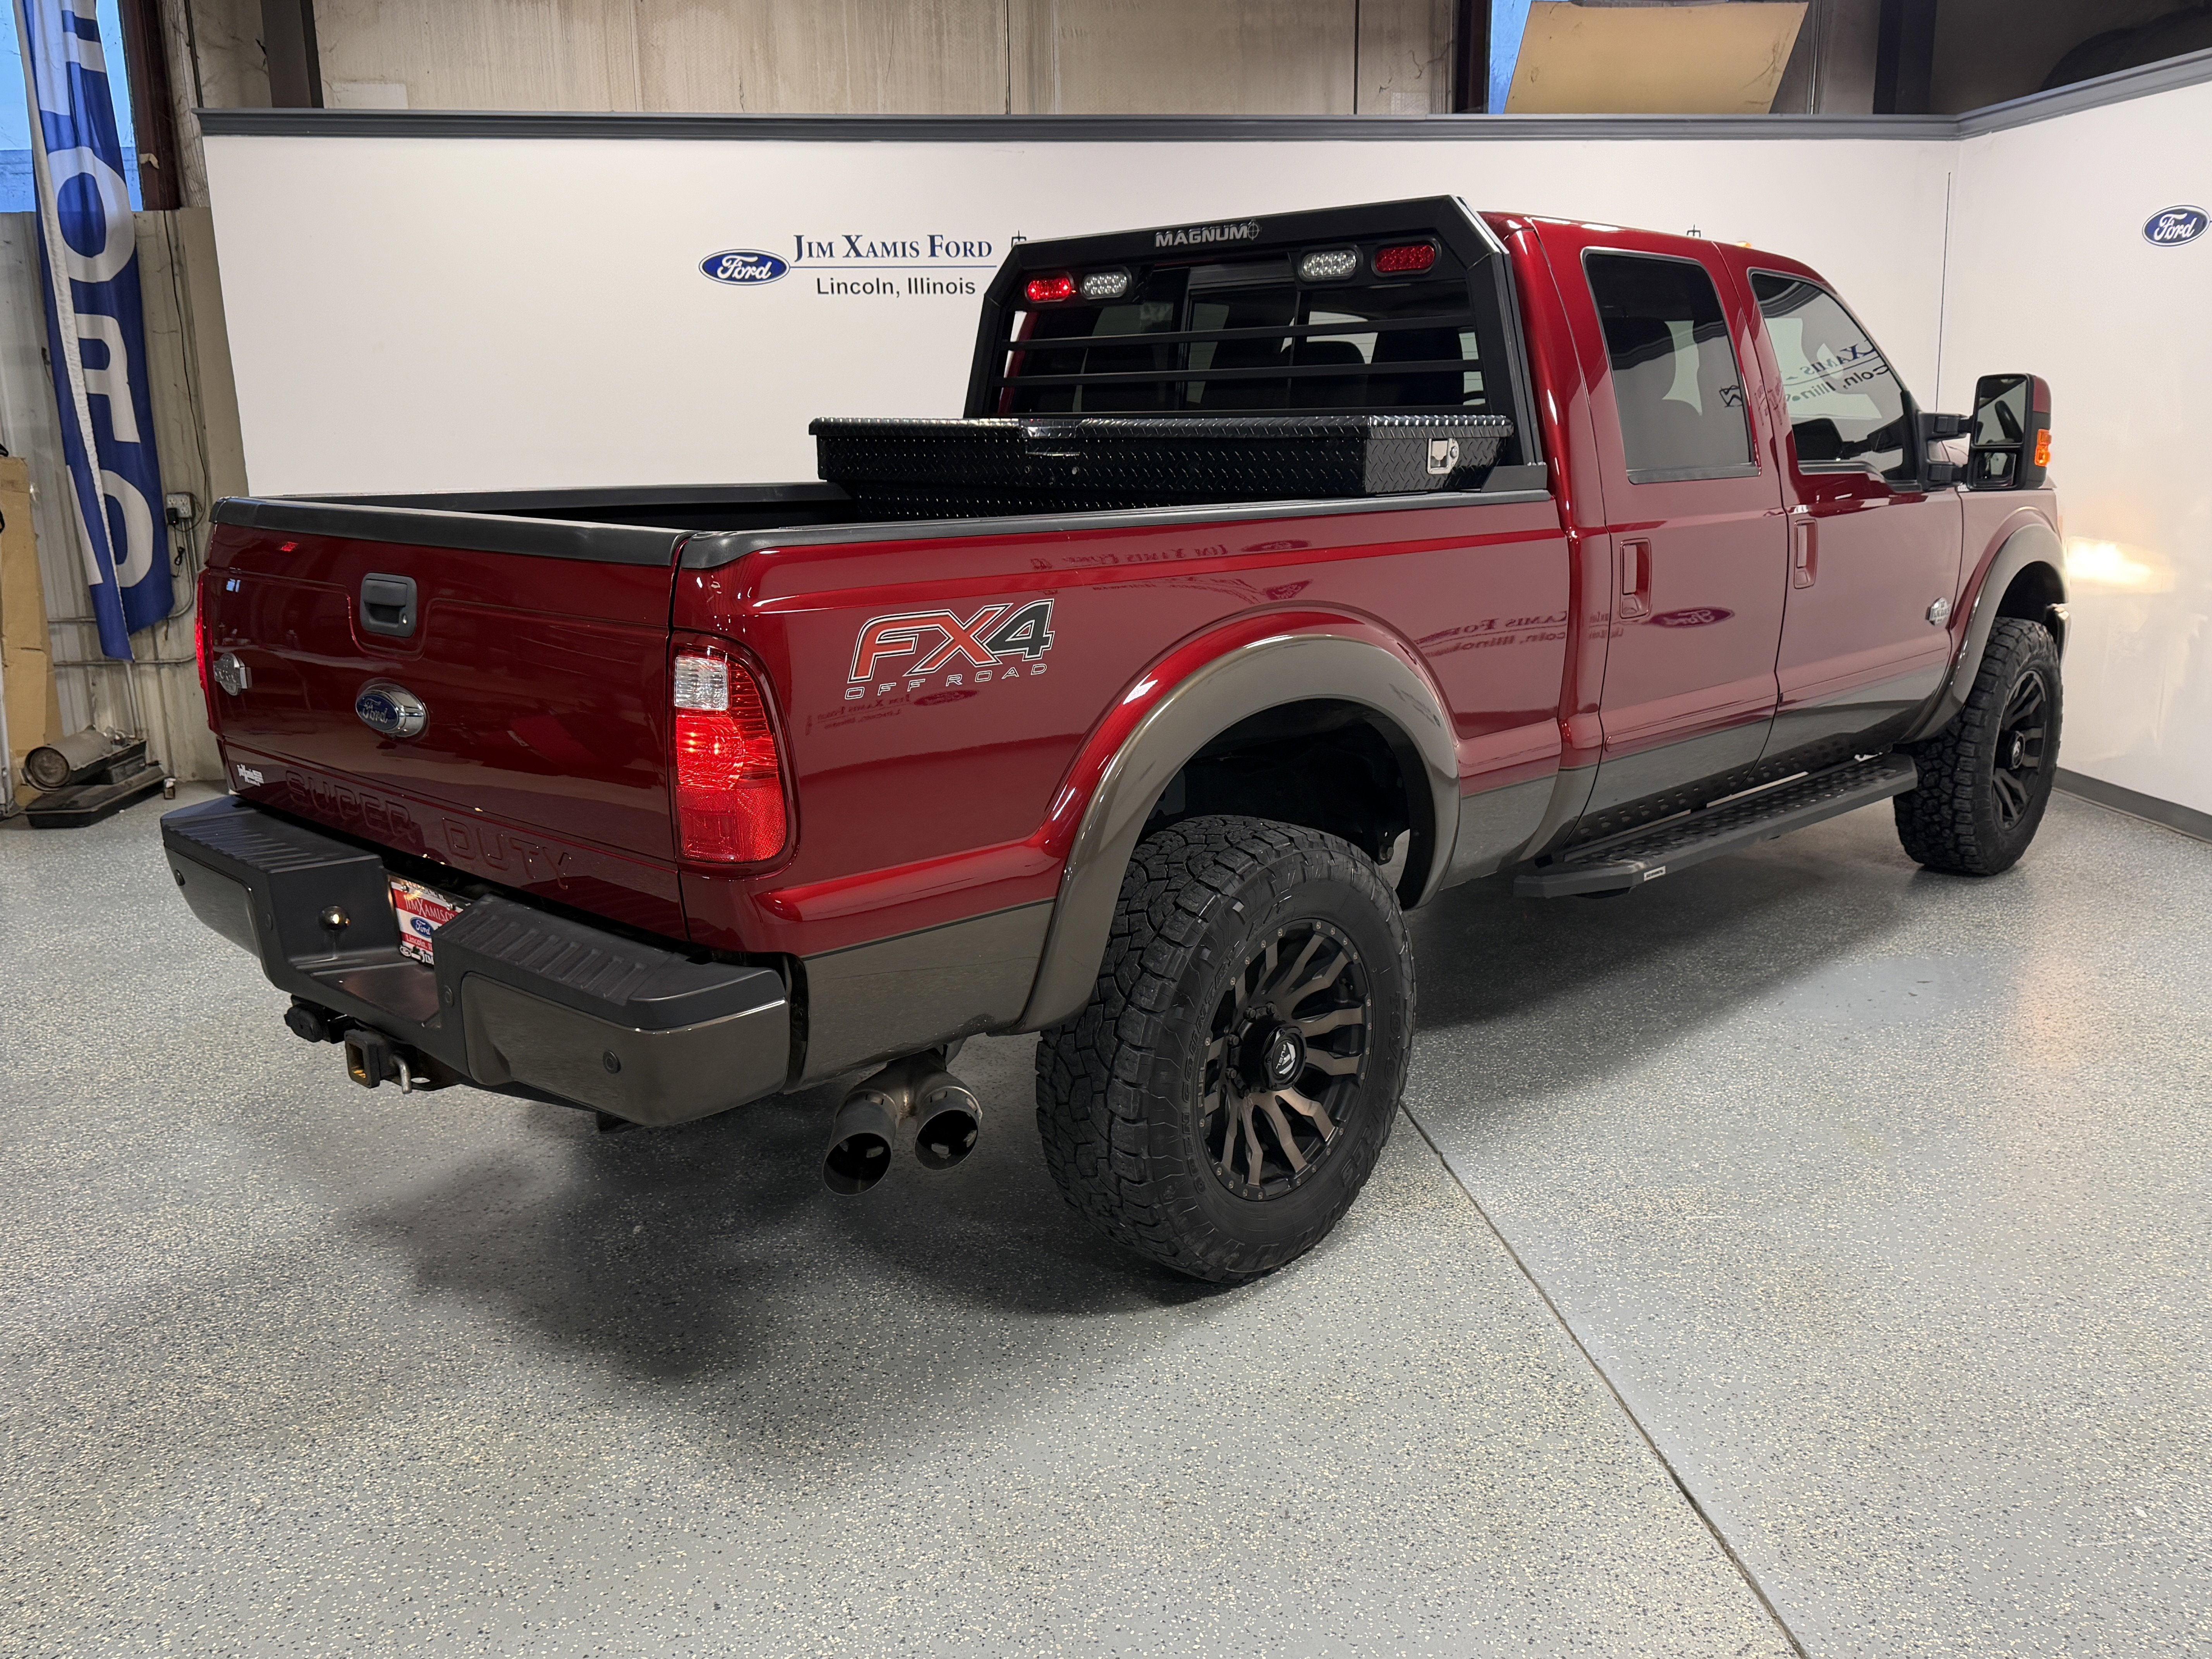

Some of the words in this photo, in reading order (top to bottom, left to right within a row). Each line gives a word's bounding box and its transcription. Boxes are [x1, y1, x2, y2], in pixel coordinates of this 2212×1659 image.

[793, 234, 834, 263] JIM
[842, 234, 920, 258] XAMIS
[927, 234, 993, 258] FORD
[1155, 223, 1248, 247] MAGNUM
[816, 278, 901, 299] Lincoln,
[907, 277, 976, 295] Illinois
[847, 599, 1055, 684] FX4
[844, 678, 926, 700] OFF
[945, 663, 1048, 687] ROAD
[286, 770, 416, 843] SUPER
[1276, 1044, 1287, 1070] FUEL
[1198, 1058, 1207, 1108] FUEL
